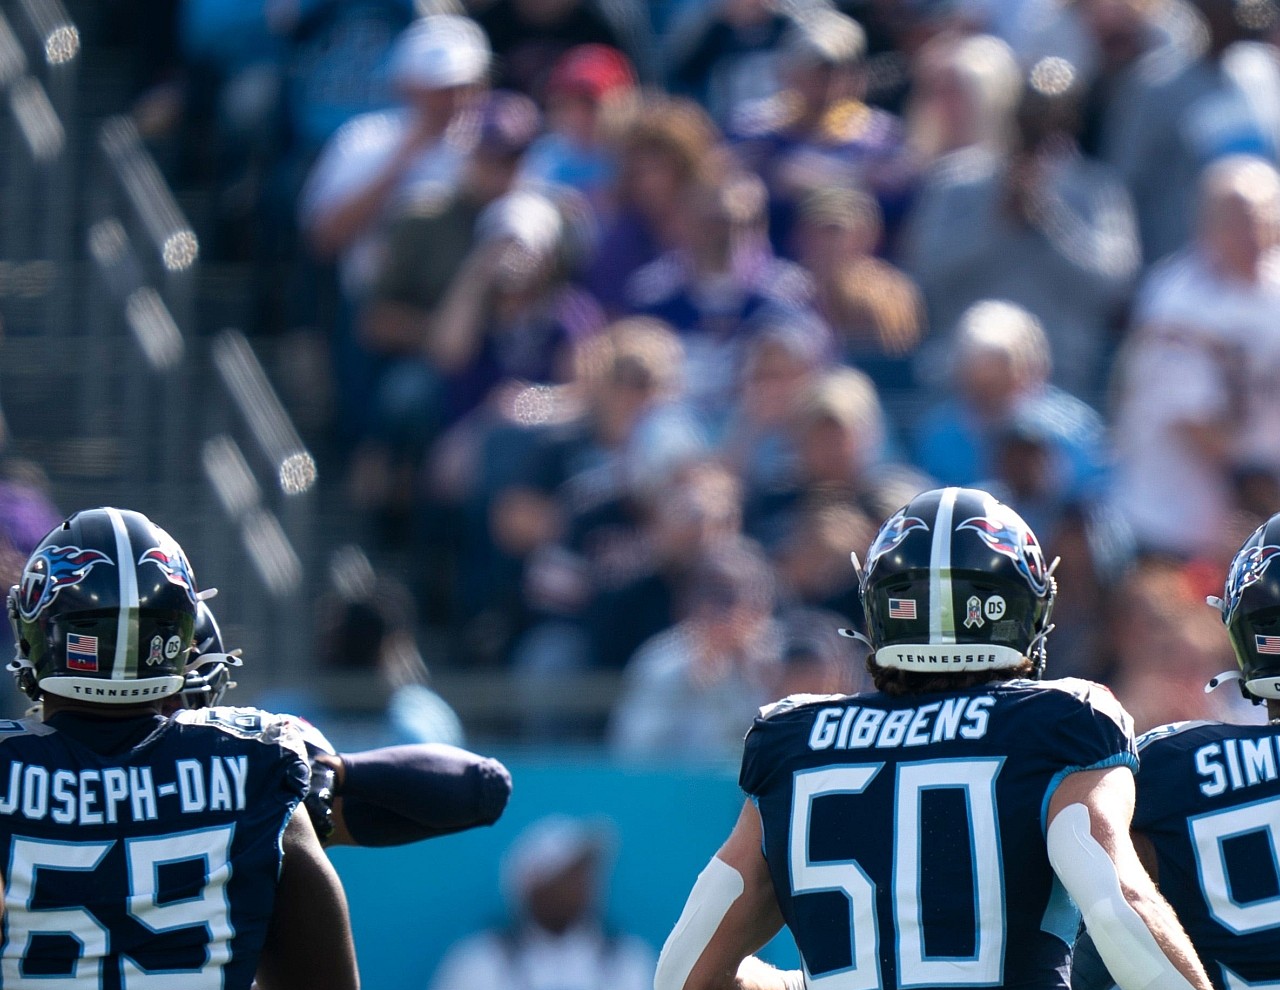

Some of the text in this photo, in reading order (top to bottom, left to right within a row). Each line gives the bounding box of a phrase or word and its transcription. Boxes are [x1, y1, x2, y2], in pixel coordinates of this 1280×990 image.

[989, 602, 1002, 614] DS
[167, 641, 179, 653] DS
[897, 654, 996, 663] TENNESSEE
[73, 685, 168, 696] TENNESSEE
[808, 695, 997, 751] GIBBENS
[0, 755, 248, 826] JOSEPH-DAY
